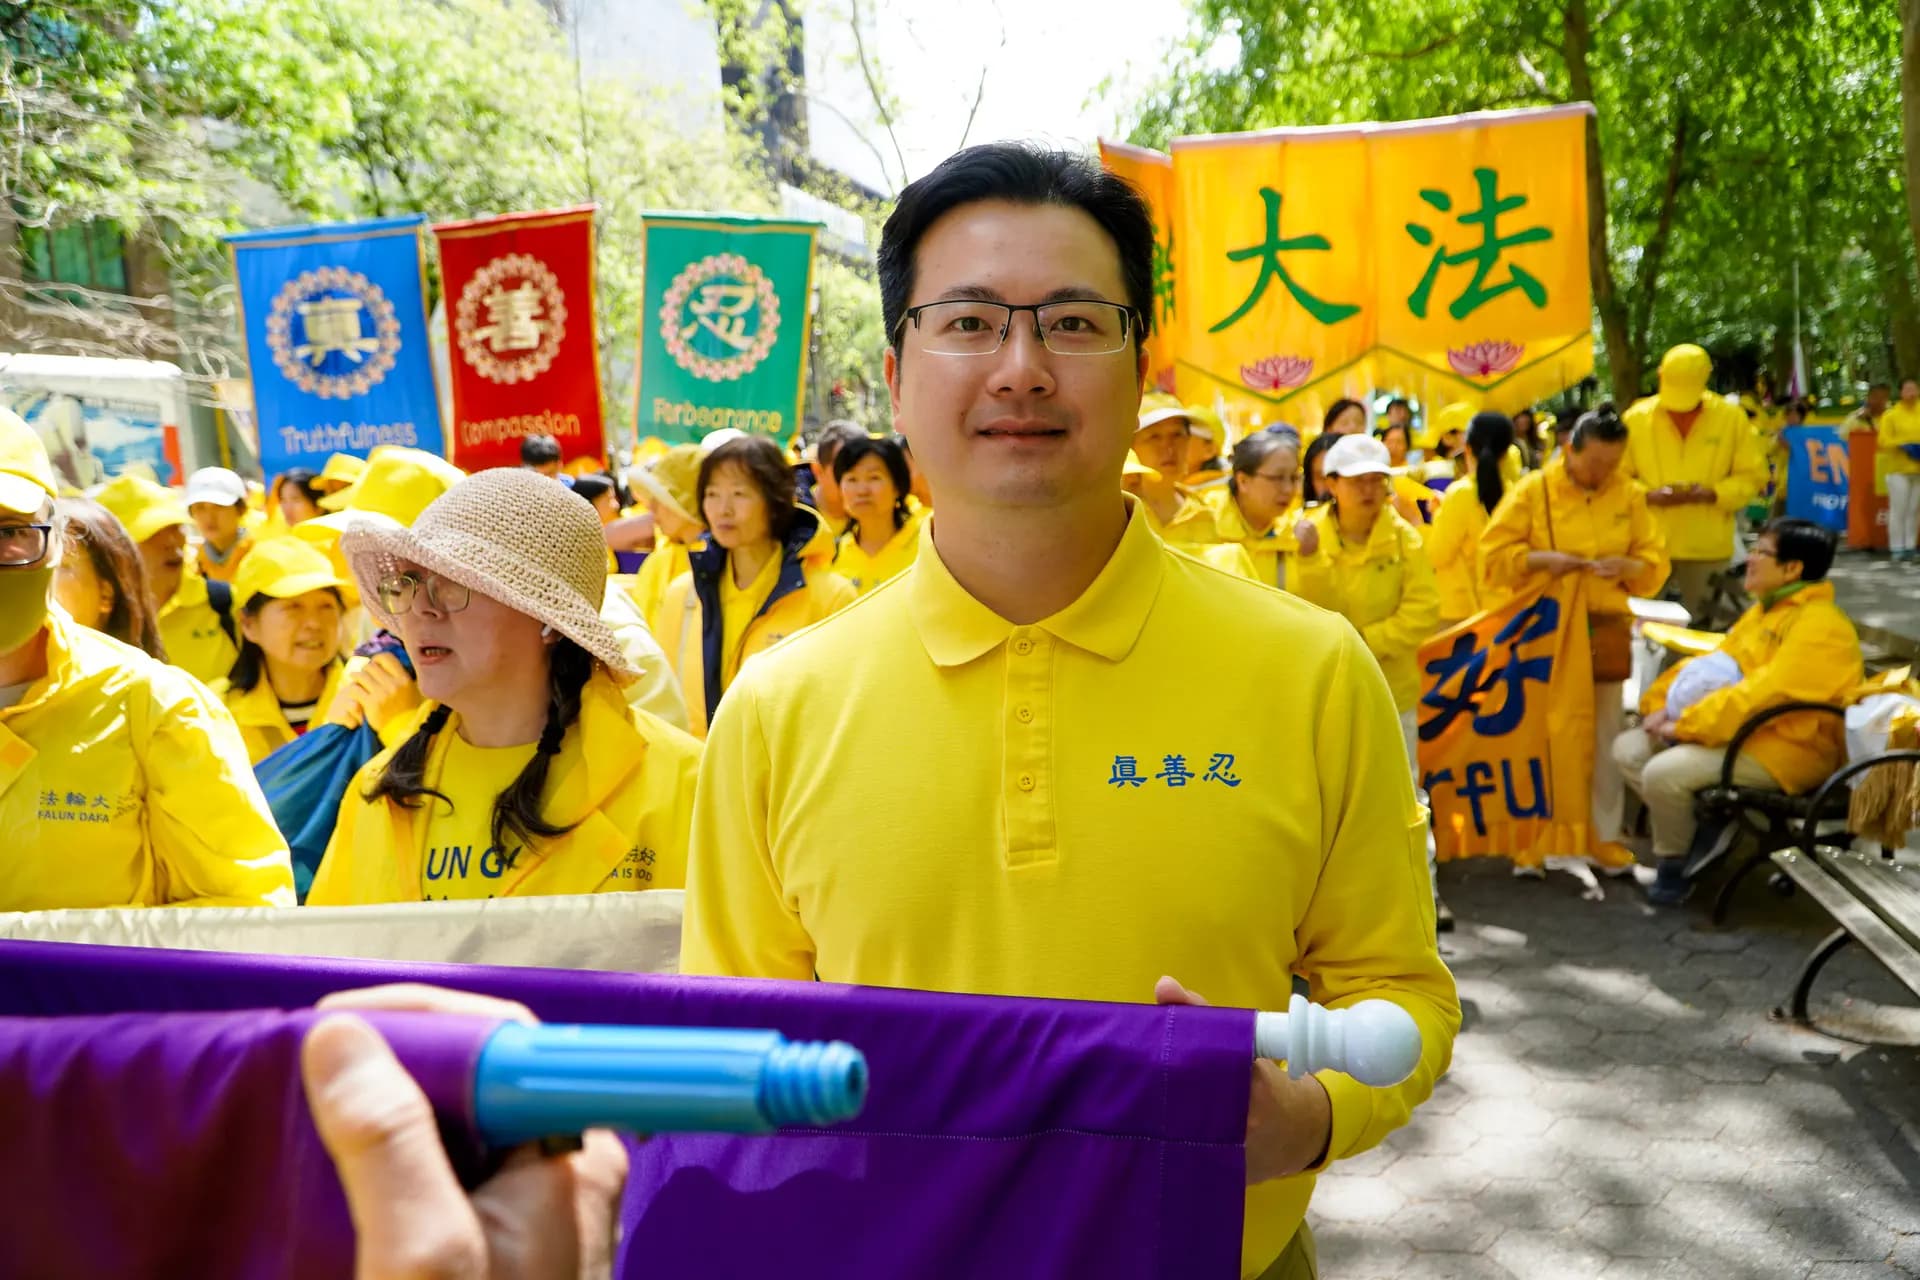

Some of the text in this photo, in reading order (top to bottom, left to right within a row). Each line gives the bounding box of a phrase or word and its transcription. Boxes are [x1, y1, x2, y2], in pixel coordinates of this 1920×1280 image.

[681, 285, 755, 351] 忍
[653, 397, 782, 432] Forbearance
[280, 421, 418, 454] Truthfulness
[1418, 594, 1560, 742] 好
[38, 810, 109, 824] FALUN DAFA
